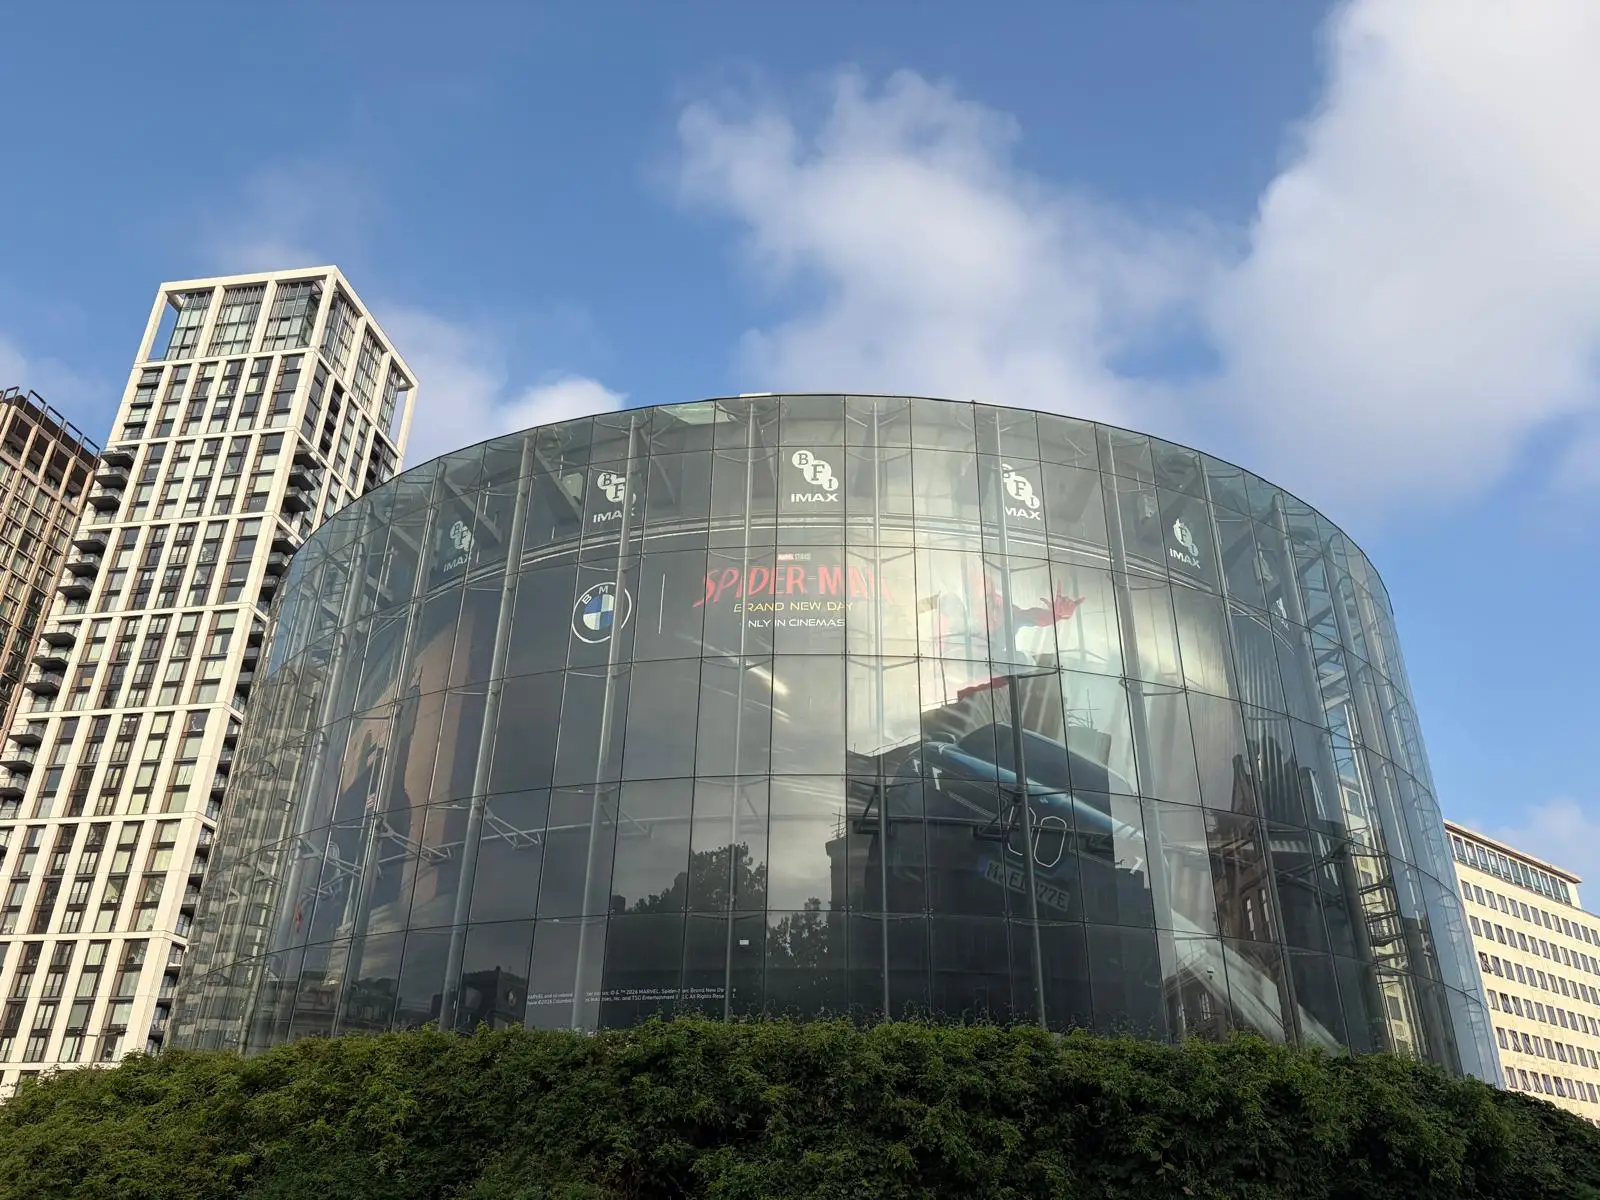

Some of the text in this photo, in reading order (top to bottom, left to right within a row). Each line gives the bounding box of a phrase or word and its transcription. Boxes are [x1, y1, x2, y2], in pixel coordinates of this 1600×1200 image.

[795, 452, 836, 489] BFI
[791, 493, 838, 503] IMAX
[1005, 506, 1041, 520] MAX
[1169, 548, 1201, 569] IMAX
[790, 601, 822, 611] NEW
[827, 601, 854, 612] DAY
[740, 618, 845, 628] NLY IN CINEMAS
